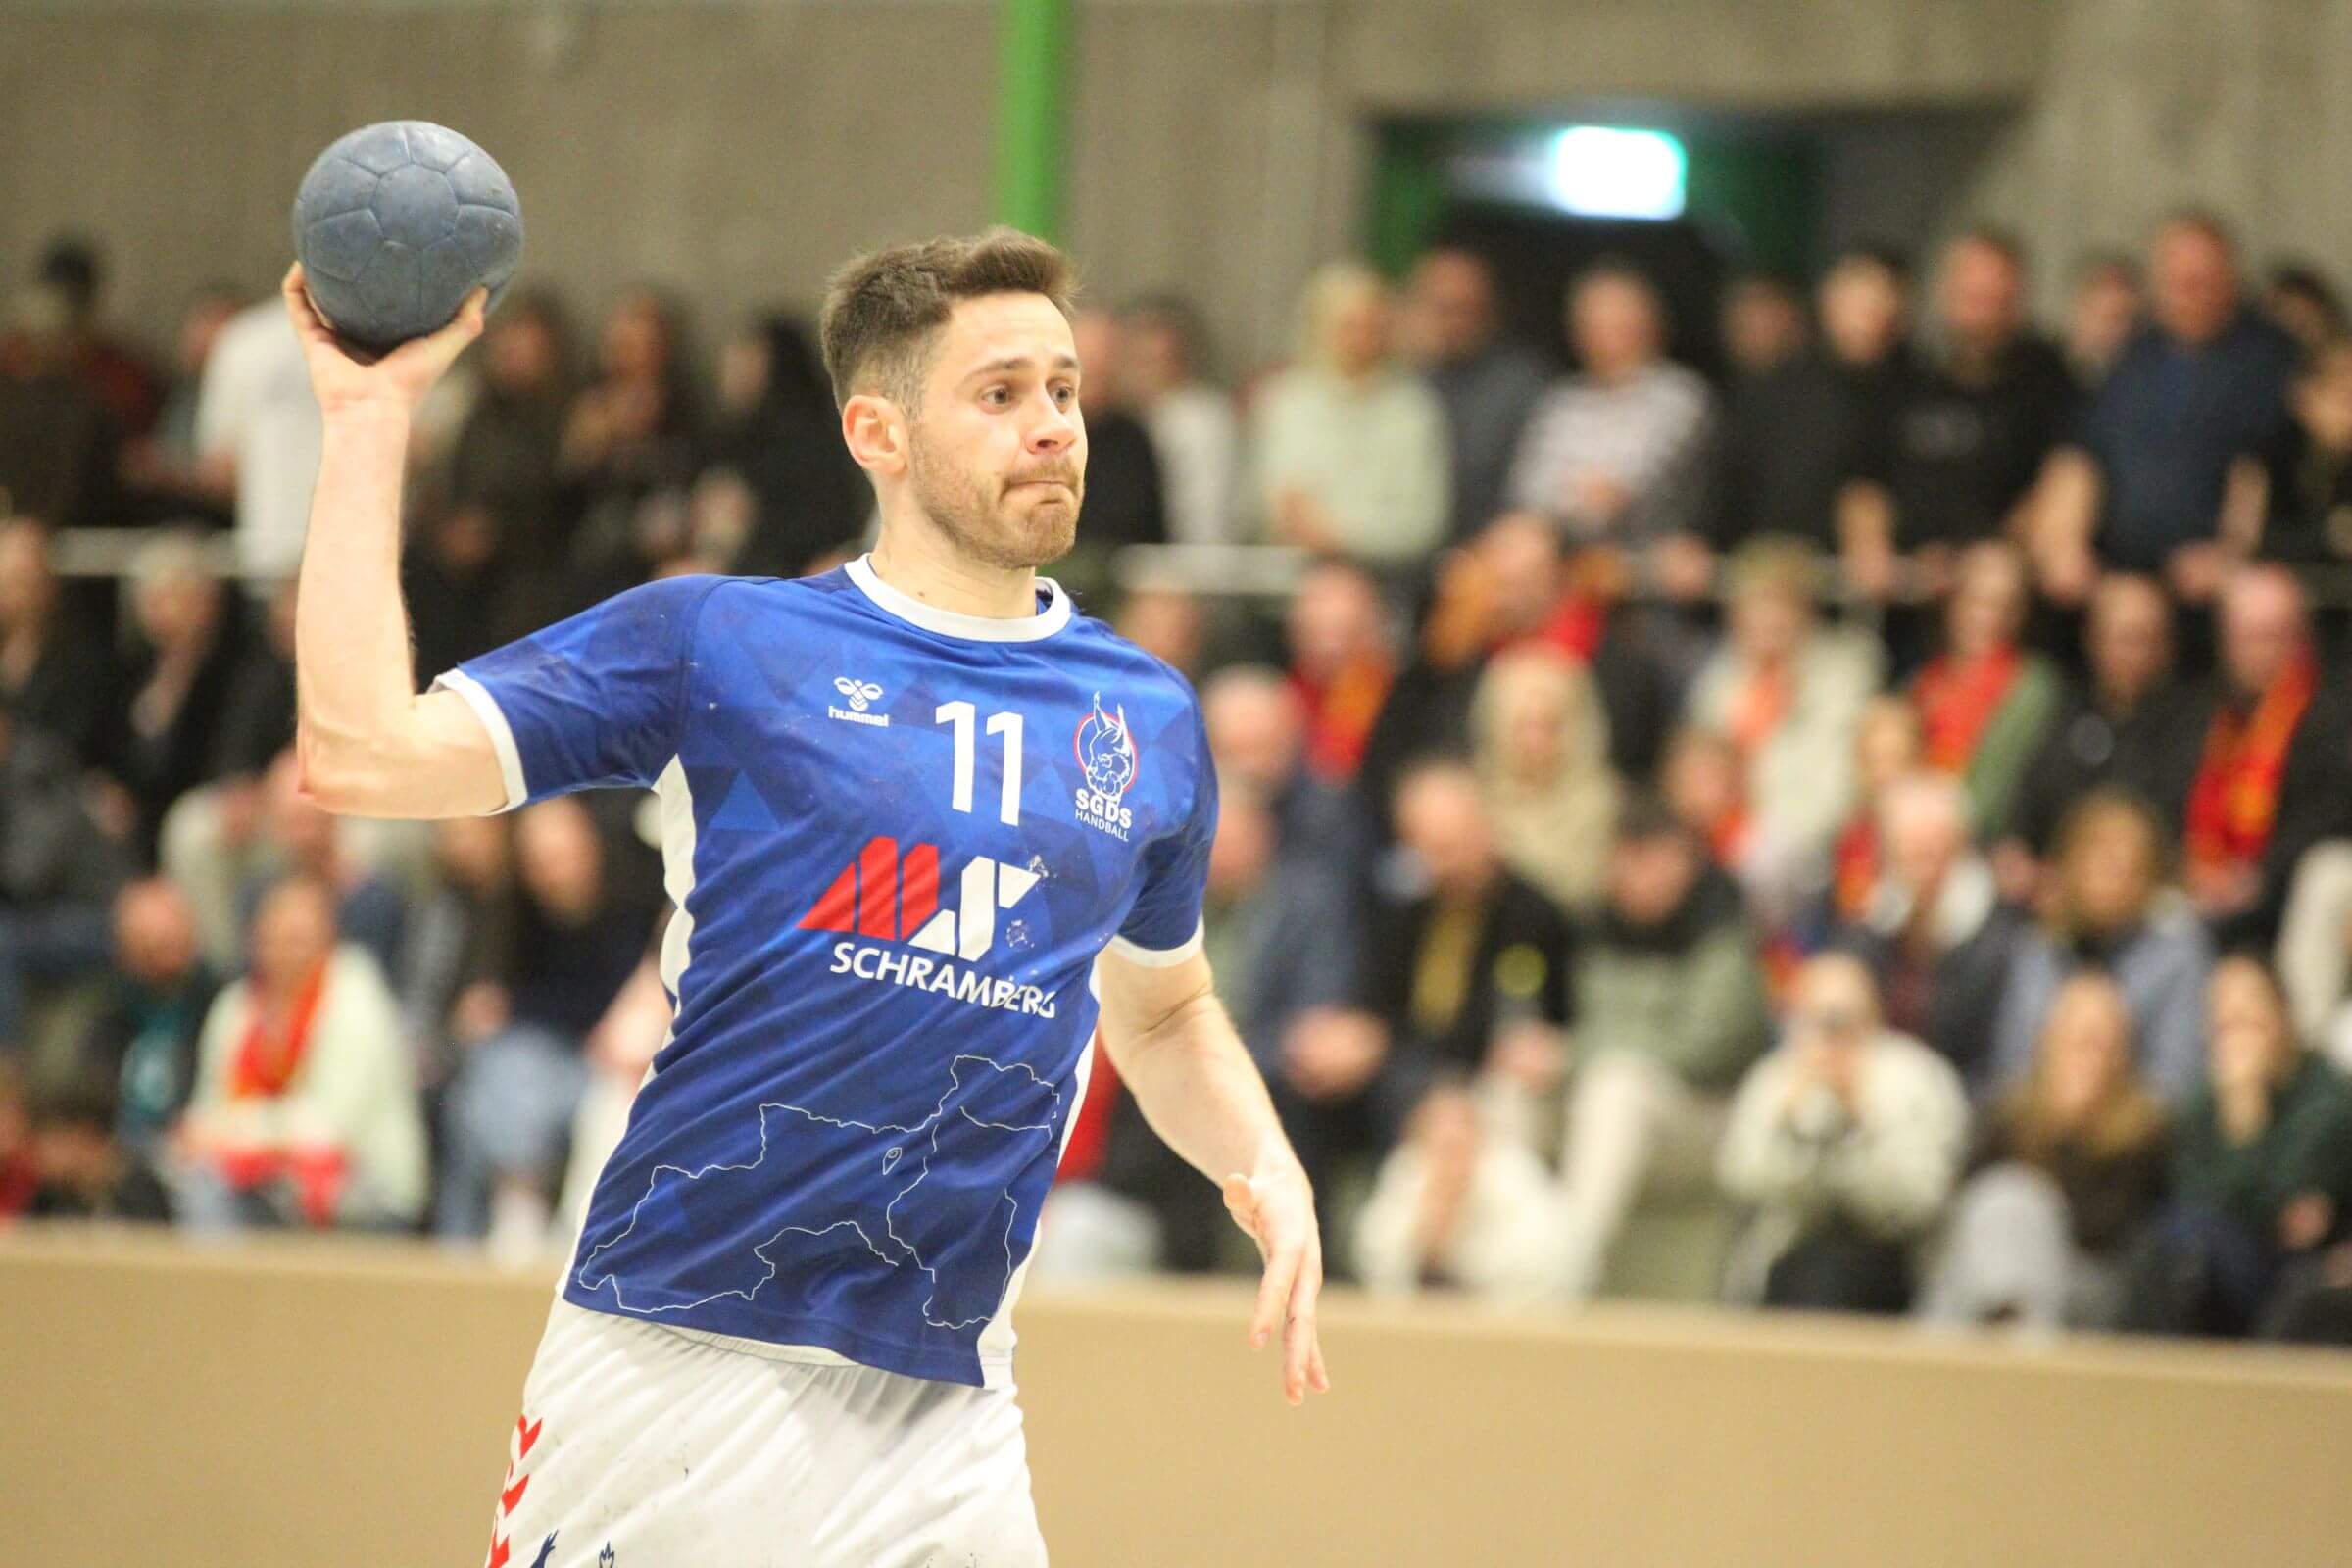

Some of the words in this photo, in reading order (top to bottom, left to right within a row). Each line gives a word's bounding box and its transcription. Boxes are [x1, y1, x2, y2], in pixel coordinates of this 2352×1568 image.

[828, 705, 889, 728] hummel
[935, 700, 1024, 827] 11
[1075, 788, 1132, 829] SGDS
[1075, 808, 1129, 842] HANDBALL
[829, 942, 1056, 1019] SCHRAMBERG
